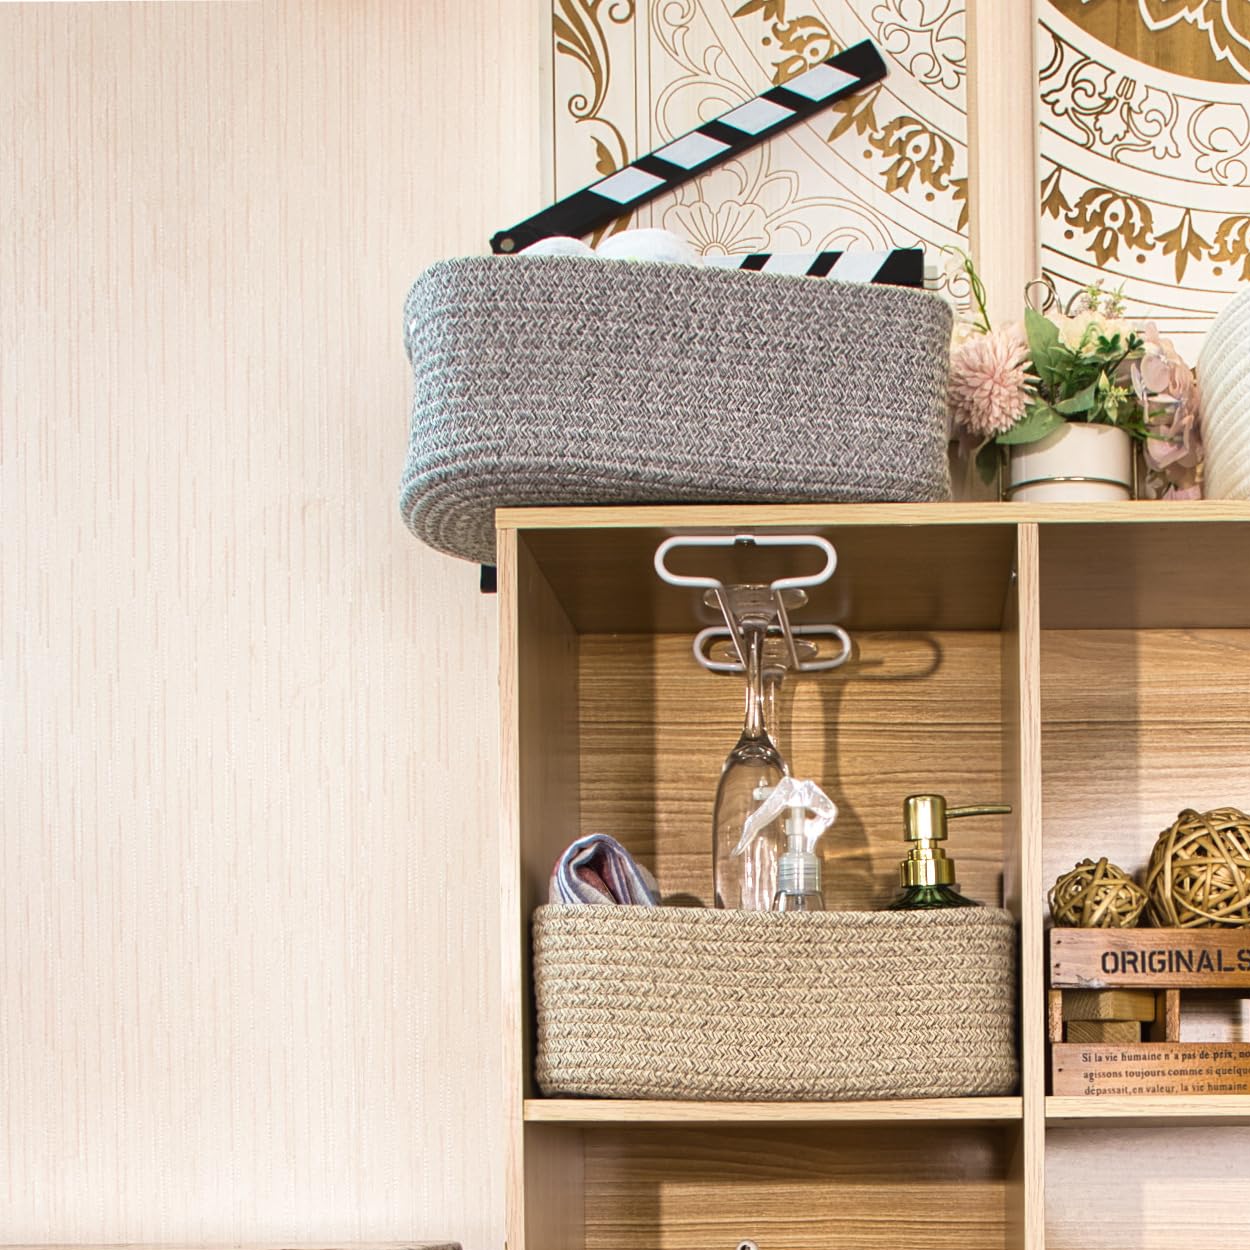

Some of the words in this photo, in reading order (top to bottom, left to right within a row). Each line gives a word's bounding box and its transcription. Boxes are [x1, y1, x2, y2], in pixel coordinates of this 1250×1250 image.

[1082, 1052, 1092, 1062] Si
[1095, 1052, 1102, 1062] la
[1105, 1052, 1118, 1062] vie
[1121, 1052, 1161, 1061] humaine
[1182, 1052, 1196, 1062] pas
[1199, 1050, 1209, 1060] de
[1083, 1070, 1122, 1083] agissons
[1125, 1068, 1165, 1079] toujours
[1168, 1068, 1203, 1076] comme
[1206, 1066, 1213, 1075] si
[1180, 1083, 1189, 1092] la
[1192, 1083, 1205, 1092] vie
[1208, 1082, 1248, 1091] humaine
